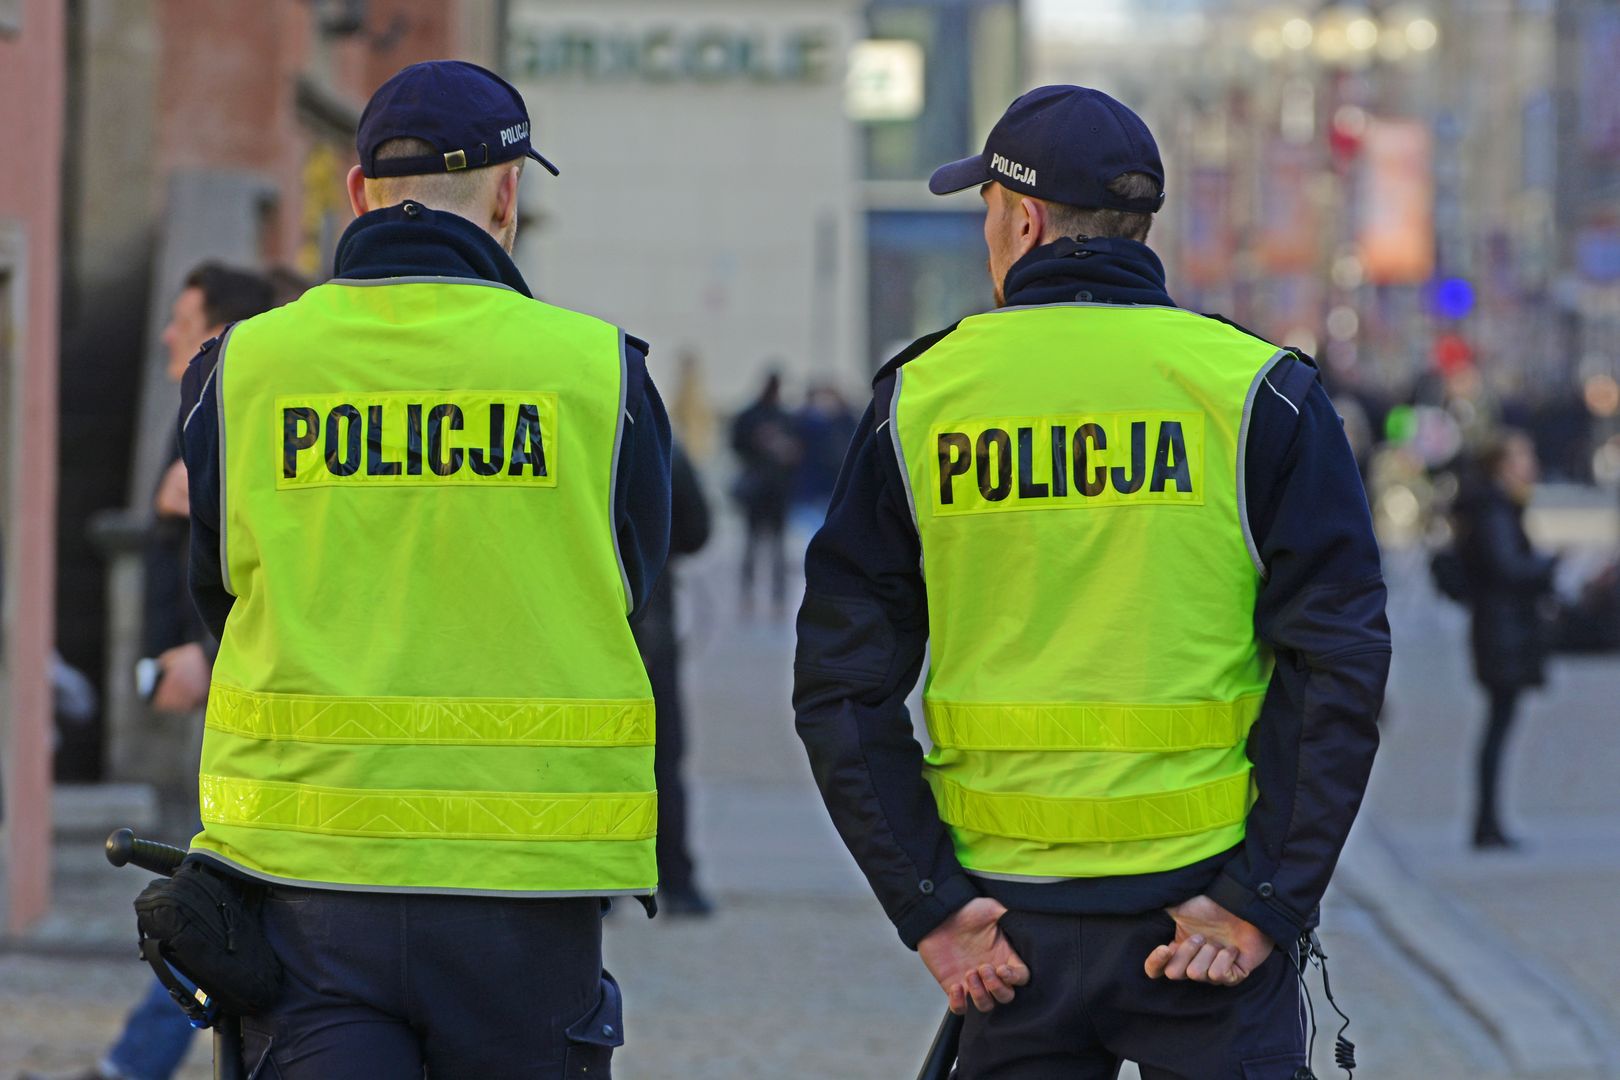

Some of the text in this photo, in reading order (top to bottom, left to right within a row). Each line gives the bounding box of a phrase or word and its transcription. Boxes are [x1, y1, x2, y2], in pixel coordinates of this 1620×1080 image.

[990, 152, 1037, 187] POLICJA
[283, 403, 547, 479] POLICJA
[937, 421, 1193, 505] POLICJA
